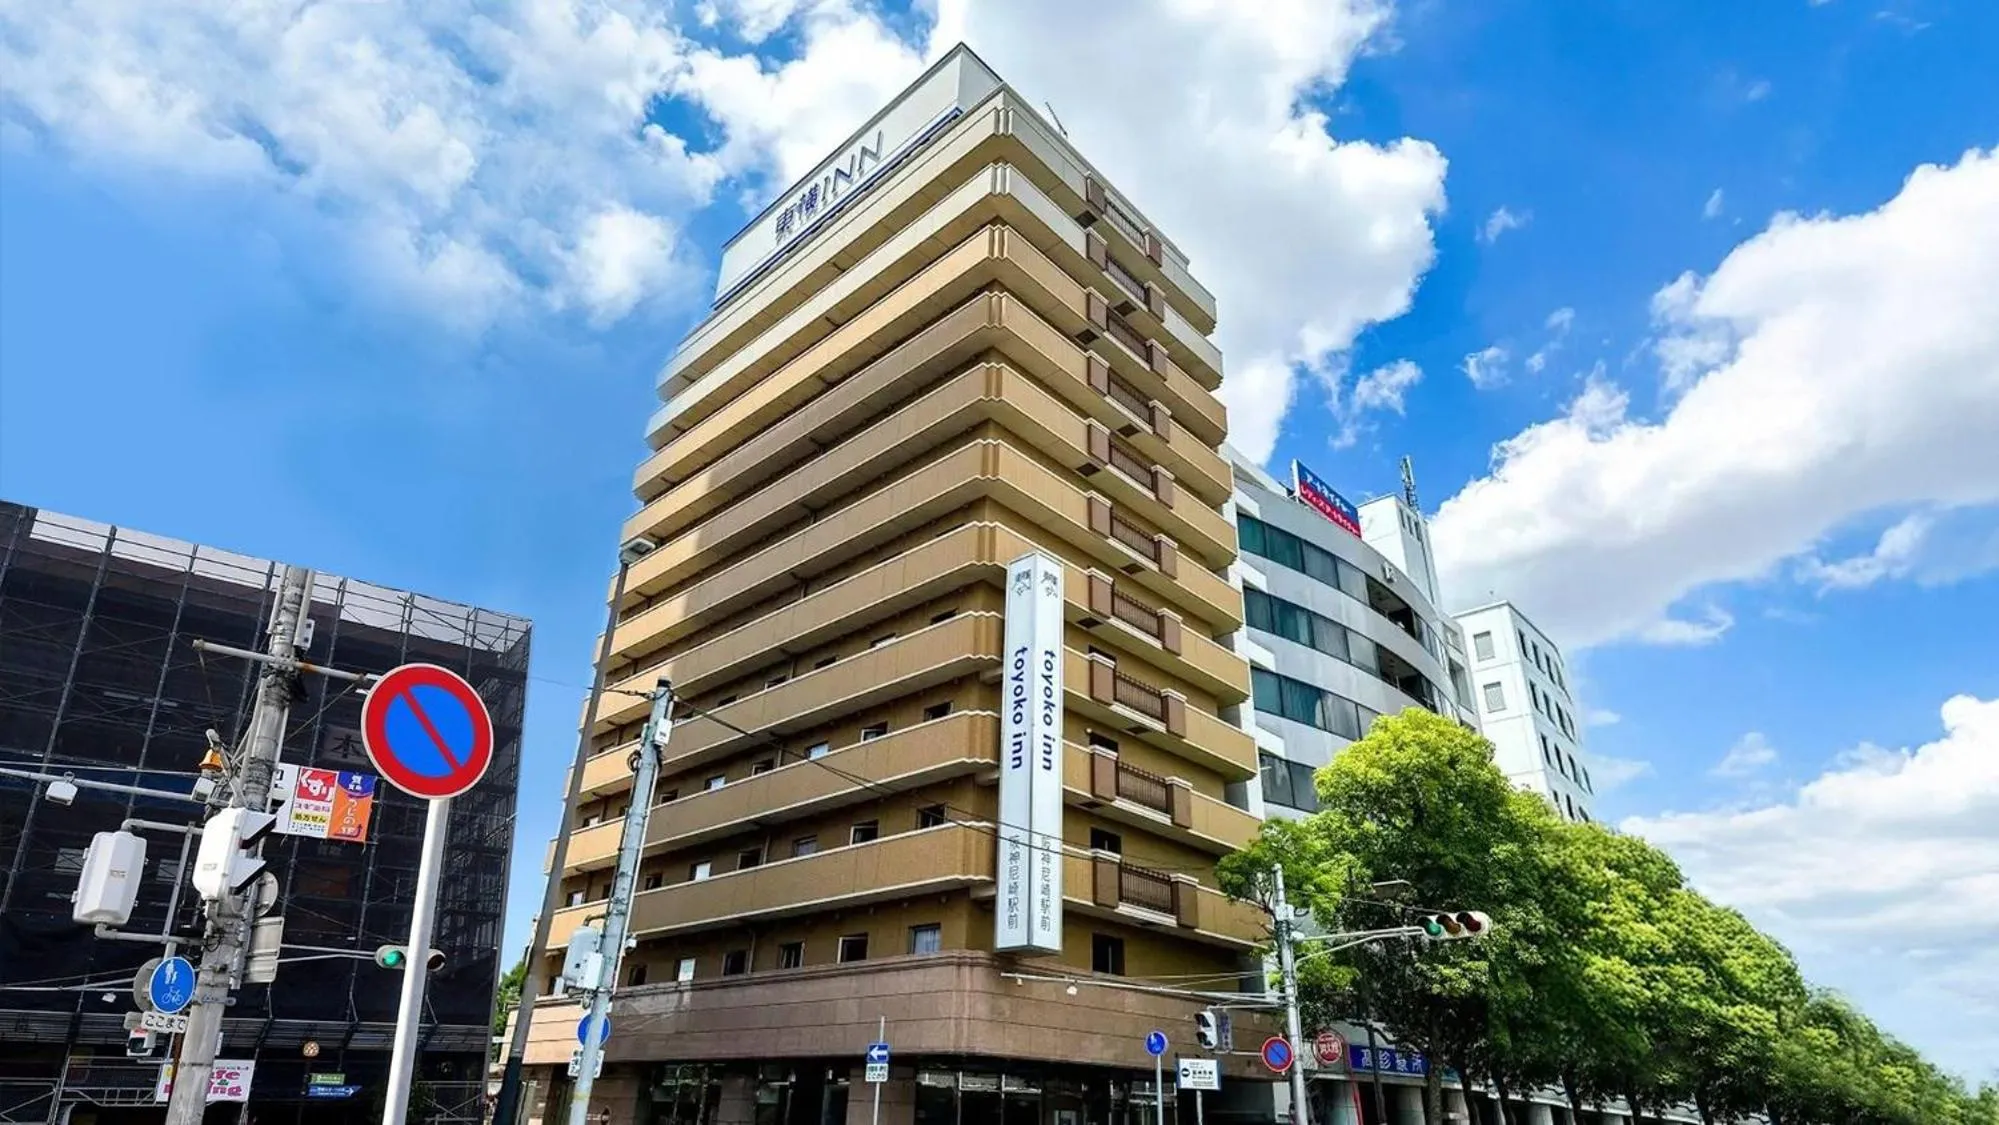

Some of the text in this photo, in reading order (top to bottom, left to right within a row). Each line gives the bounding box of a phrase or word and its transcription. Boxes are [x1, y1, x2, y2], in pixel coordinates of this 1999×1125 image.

[1011, 646, 1028, 770] toyoko inn
[1041, 650, 1056, 771] toyoko inn
[144, 1014, 187, 1030] ここまで
